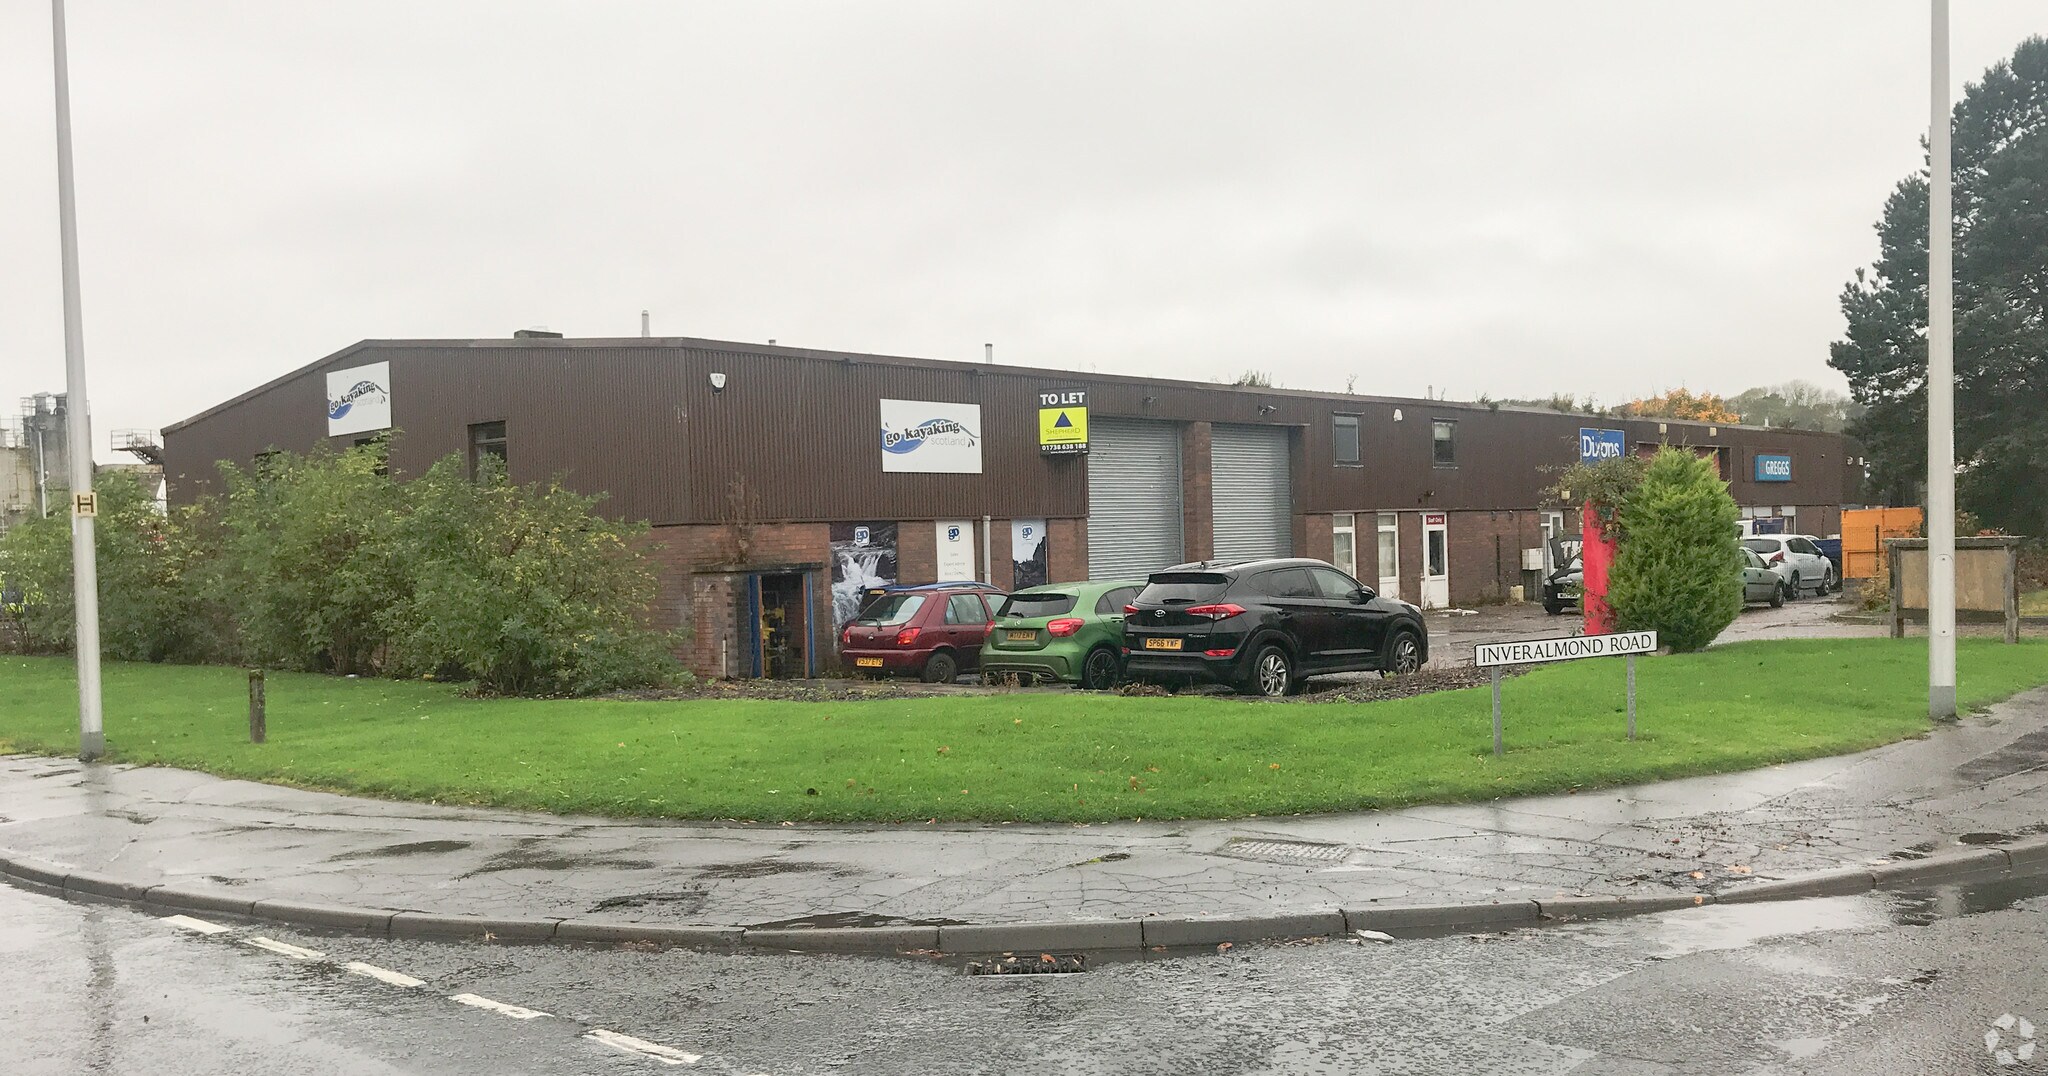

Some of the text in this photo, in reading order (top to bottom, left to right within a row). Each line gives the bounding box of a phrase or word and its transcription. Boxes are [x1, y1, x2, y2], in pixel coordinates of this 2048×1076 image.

[330, 382, 375, 413] go kayaking
[1040, 392, 1085, 405] TO LET
[886, 421, 960, 445] go kayaking
[930, 437, 965, 446] scotland
[1766, 460, 1789, 475] GREGGS
[857, 530, 868, 542] go
[948, 528, 960, 540] go
[1022, 527, 1033, 538] go
[1482, 634, 1651, 663] INVERALMOND ROAD
